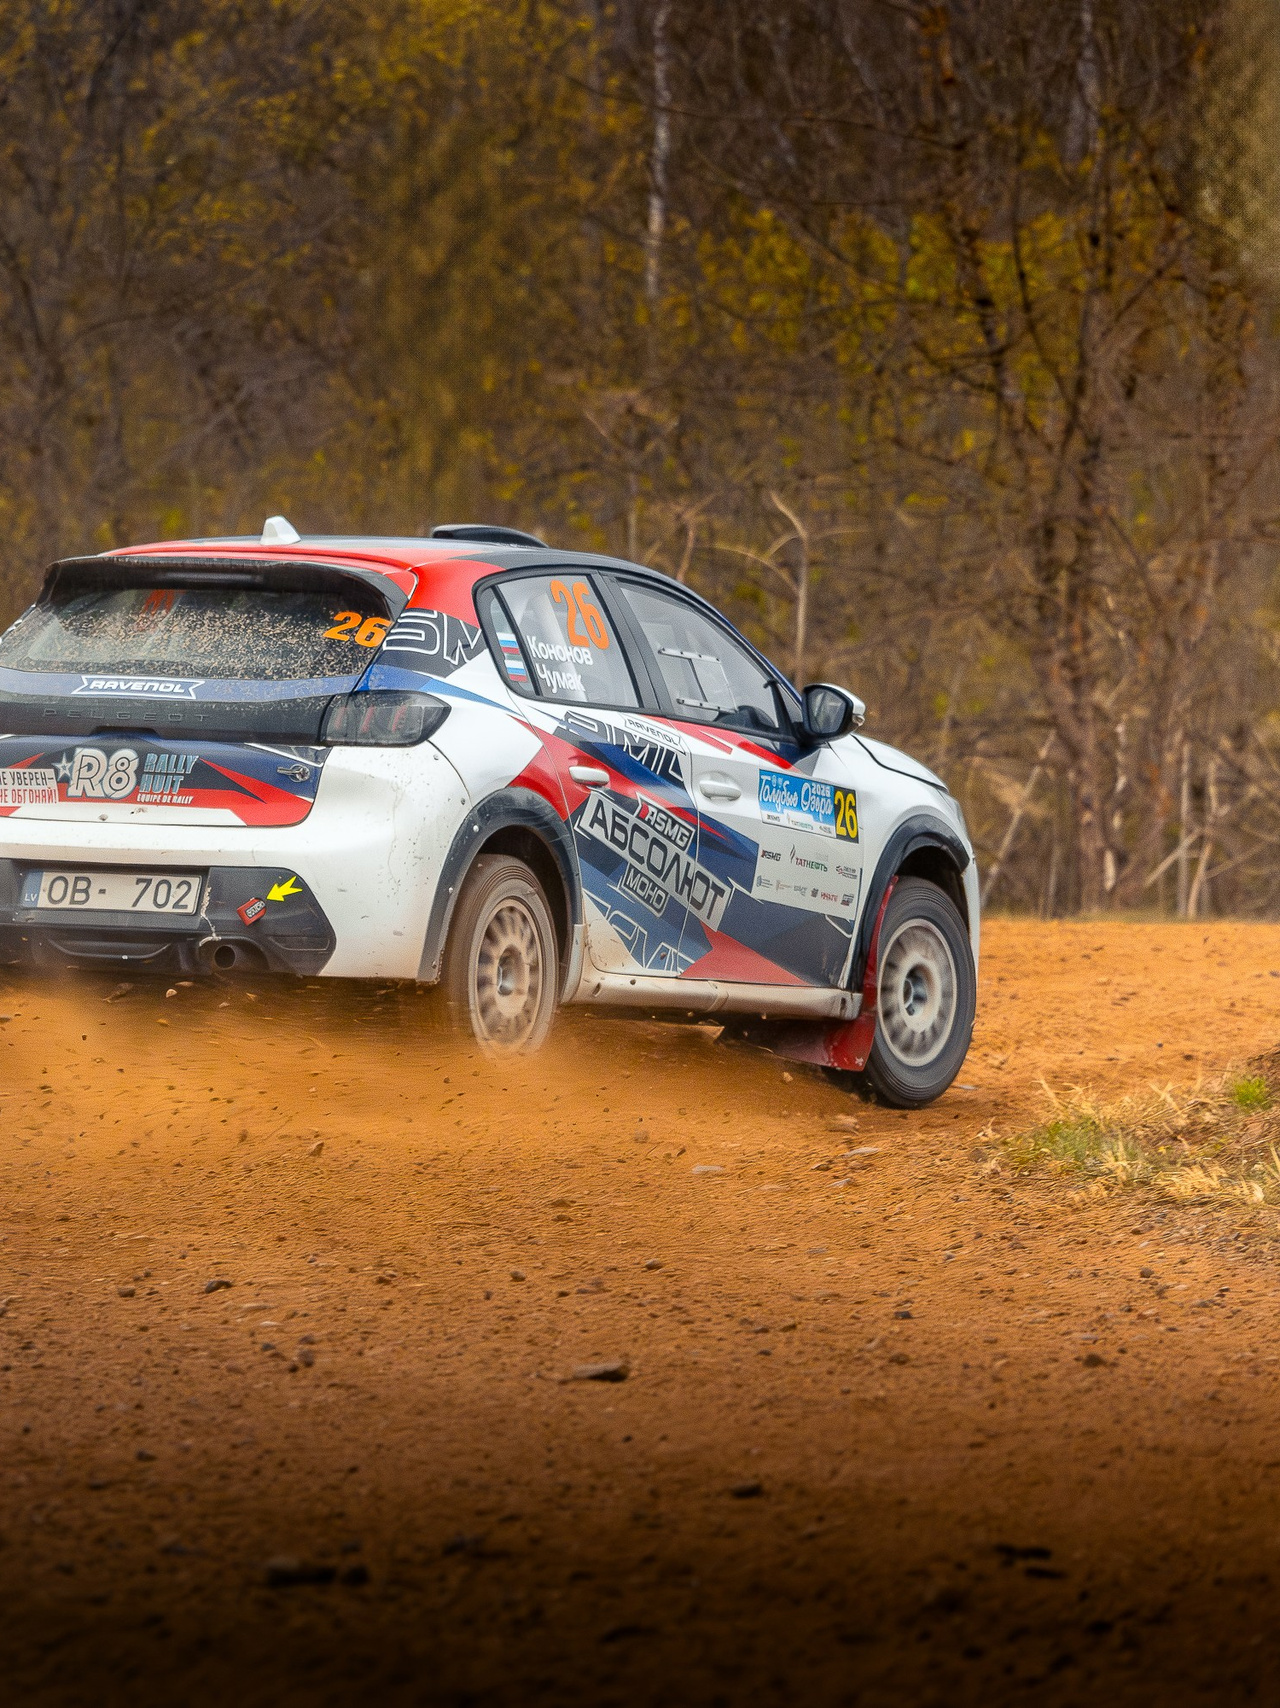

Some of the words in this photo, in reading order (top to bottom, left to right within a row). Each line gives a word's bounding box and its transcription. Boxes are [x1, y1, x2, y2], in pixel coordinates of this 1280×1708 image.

[323, 611, 392, 647] 26
[550, 580, 609, 650] 26
[526, 635, 593, 665] Кононов
[89, 680, 185, 693] RAVENOL
[535, 663, 586, 694] Чумак
[43, 708, 210, 722] PEUGEOT
[627, 719, 680, 746] RAVENOL
[67, 747, 140, 800] R8
[143, 753, 200, 774] RALLY
[11, 787, 57, 804] ОБГОНЯЙ!
[171, 795, 194, 805] RALLY
[643, 808, 690, 850] ASMG
[834, 790, 858, 839] 26
[589, 799, 726, 920] АБСОЛЮТ
[795, 857, 828, 872] ТАТНЕФТЬ
[24, 892, 38, 902] LV
[131, 877, 193, 910] 702
[626, 869, 666, 910] МОНО
